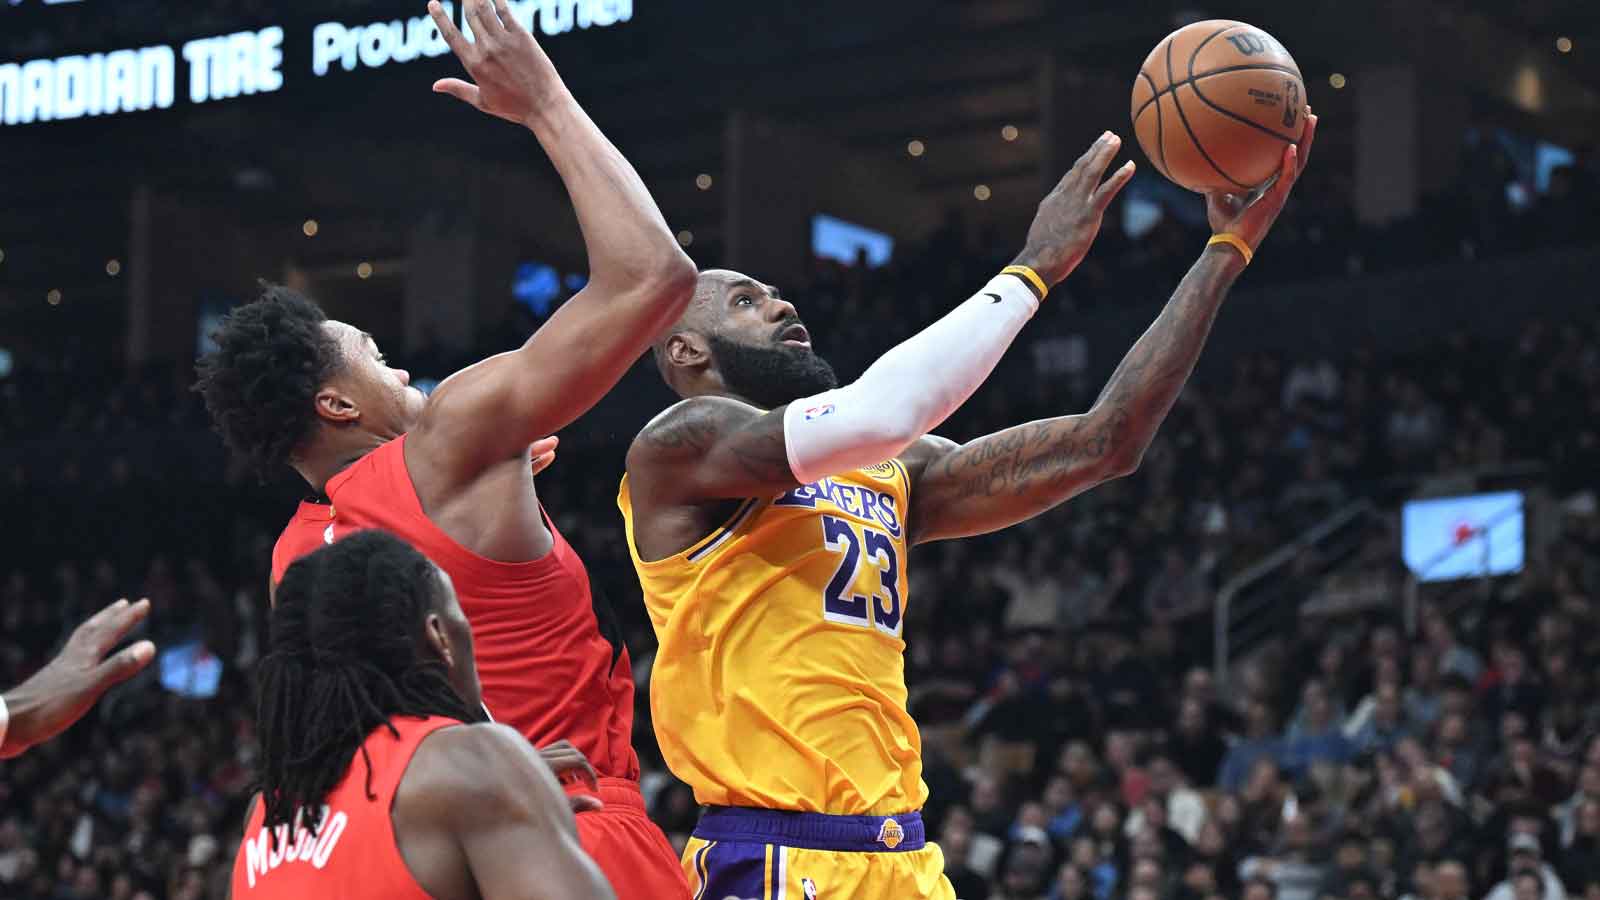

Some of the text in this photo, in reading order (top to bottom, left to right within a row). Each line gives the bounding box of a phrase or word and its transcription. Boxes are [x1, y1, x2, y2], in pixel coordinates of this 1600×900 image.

[182, 26, 284, 103] TIRE
[312, 1, 454, 76] Proud
[821, 514, 903, 637] 23
